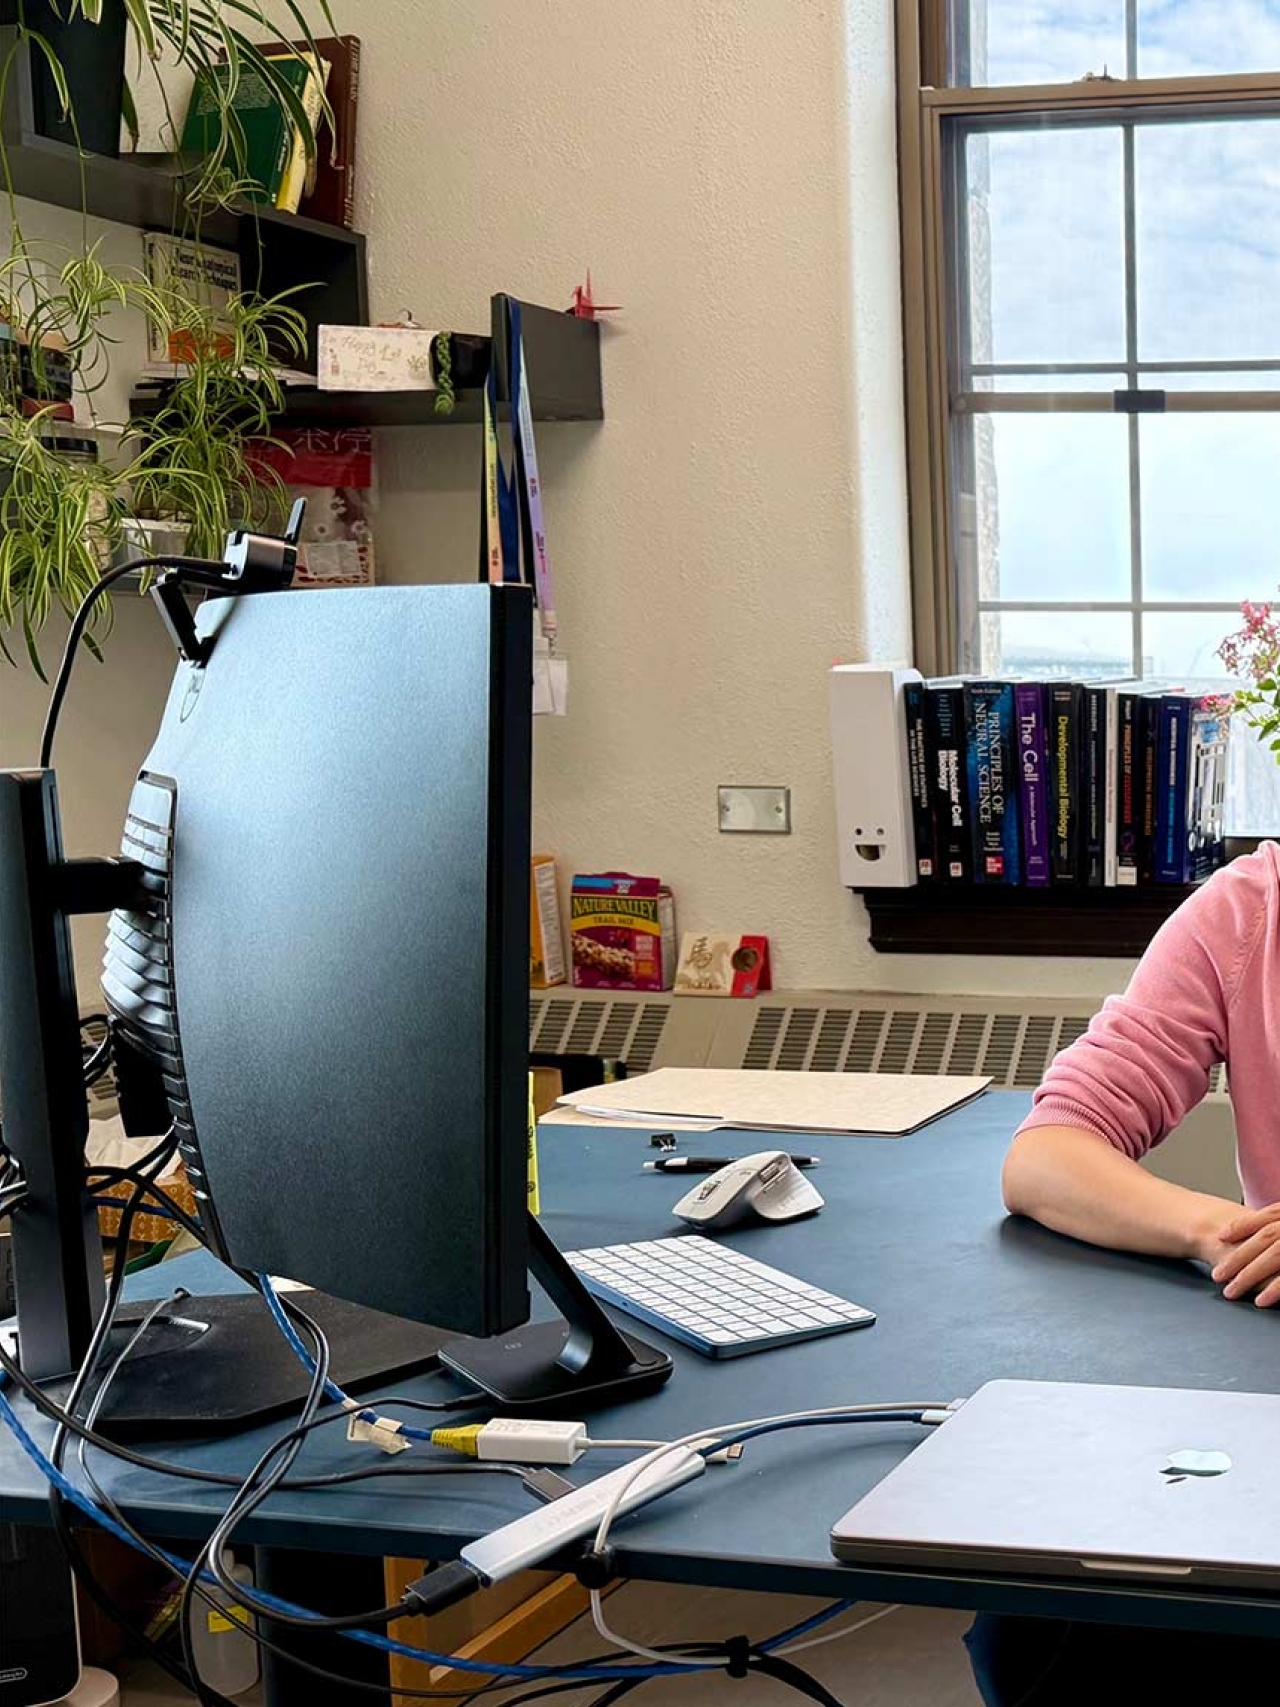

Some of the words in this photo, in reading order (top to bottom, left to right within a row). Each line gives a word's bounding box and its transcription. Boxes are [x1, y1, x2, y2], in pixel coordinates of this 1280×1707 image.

[974, 702, 989, 761] NEURAL
[1021, 712, 1036, 745] The
[938, 750, 949, 791] Biology
[988, 711, 1004, 793] PRINCIPLES
[1023, 750, 1039, 782] Cell
[1058, 715, 1070, 797] Developmental
[948, 750, 962, 804] Molecular
[978, 764, 992, 823] SCIENCE
[951, 805, 963, 827] Cell
[991, 794, 1004, 815] OF
[1057, 798, 1070, 839] Biology
[573, 897, 615, 918] NATURE
[615, 898, 656, 920] VALLEY
